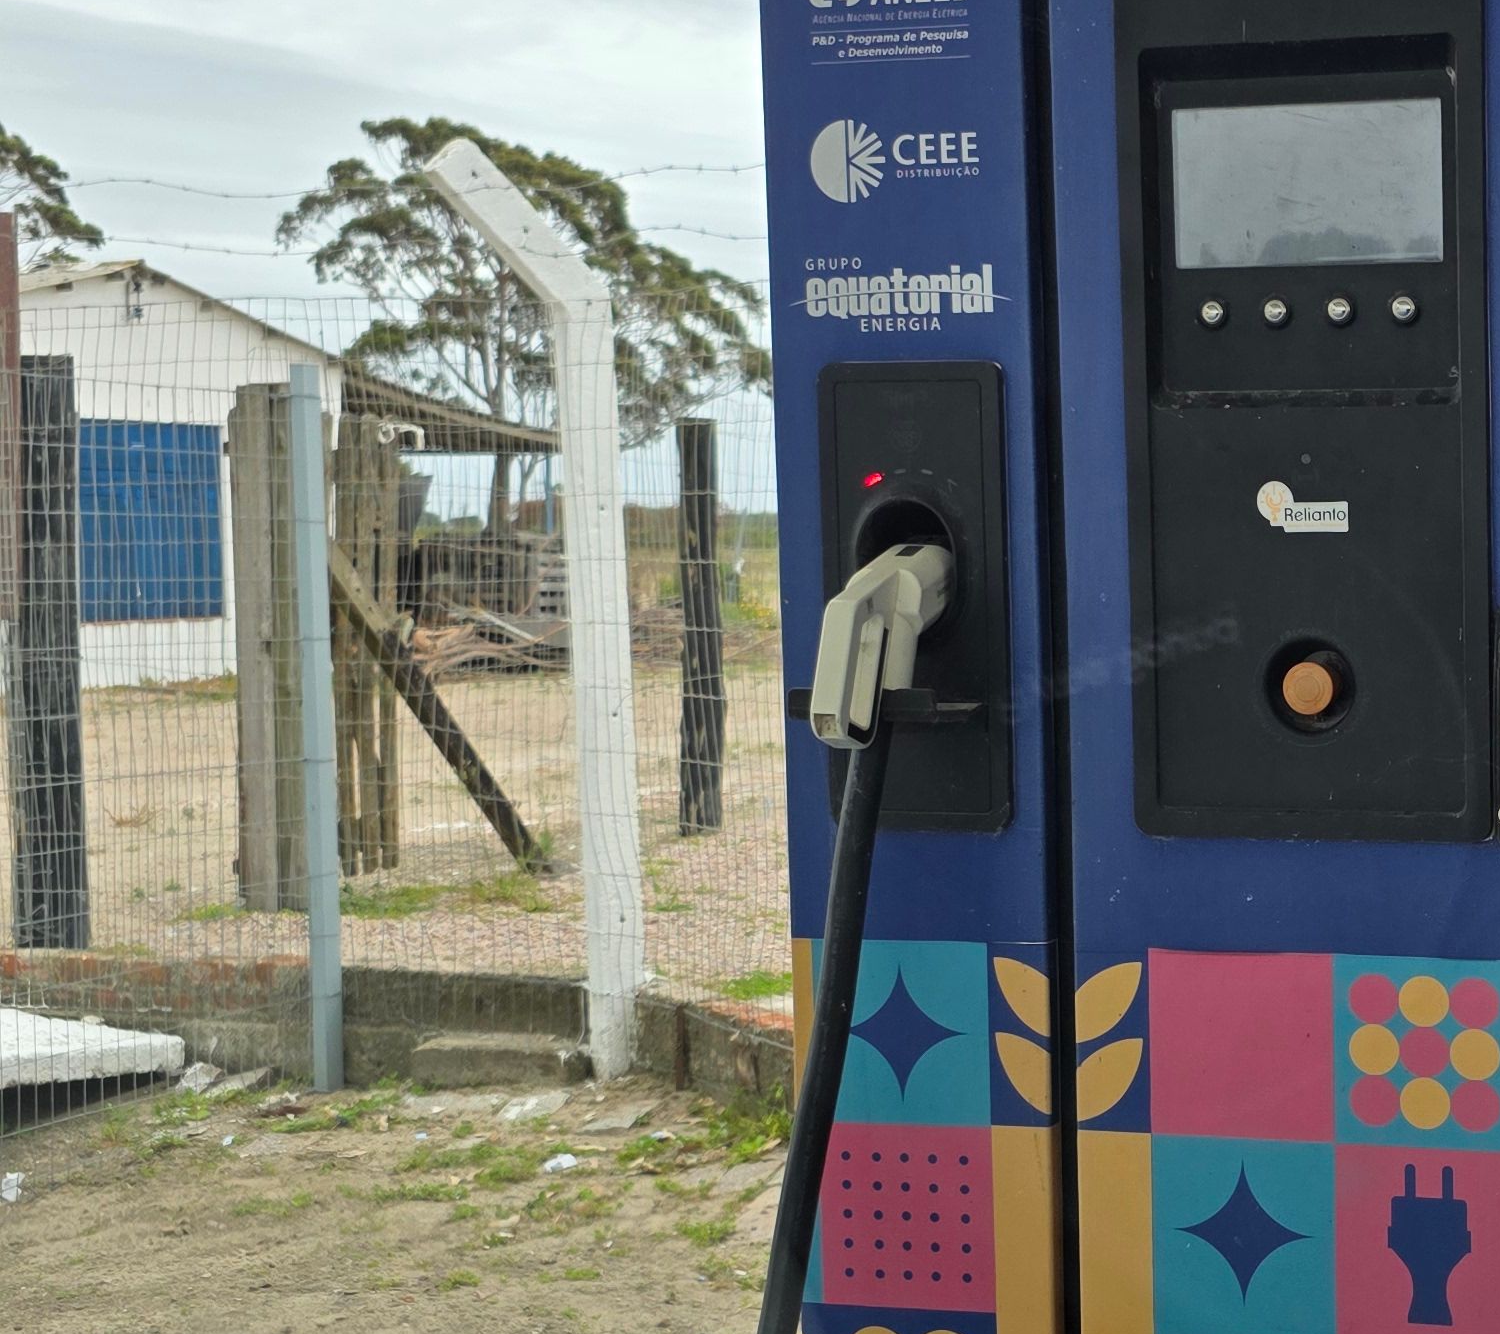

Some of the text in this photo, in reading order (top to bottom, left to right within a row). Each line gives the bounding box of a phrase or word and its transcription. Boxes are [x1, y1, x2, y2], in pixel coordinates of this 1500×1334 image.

[812, 36, 836, 46] P&D
[846, 33, 900, 47] Programa
[903, 31, 917, 42] de
[920, 29, 969, 43] Pesquisa
[838, 45, 943, 58] e Desenvolvimento
[892, 131, 980, 166] CEEE
[896, 165, 980, 179] DISTRIBUIÇÃO
[805, 257, 862, 271] GRUPO
[806, 264, 994, 319] equatorial
[860, 317, 942, 333] ENERGIA
